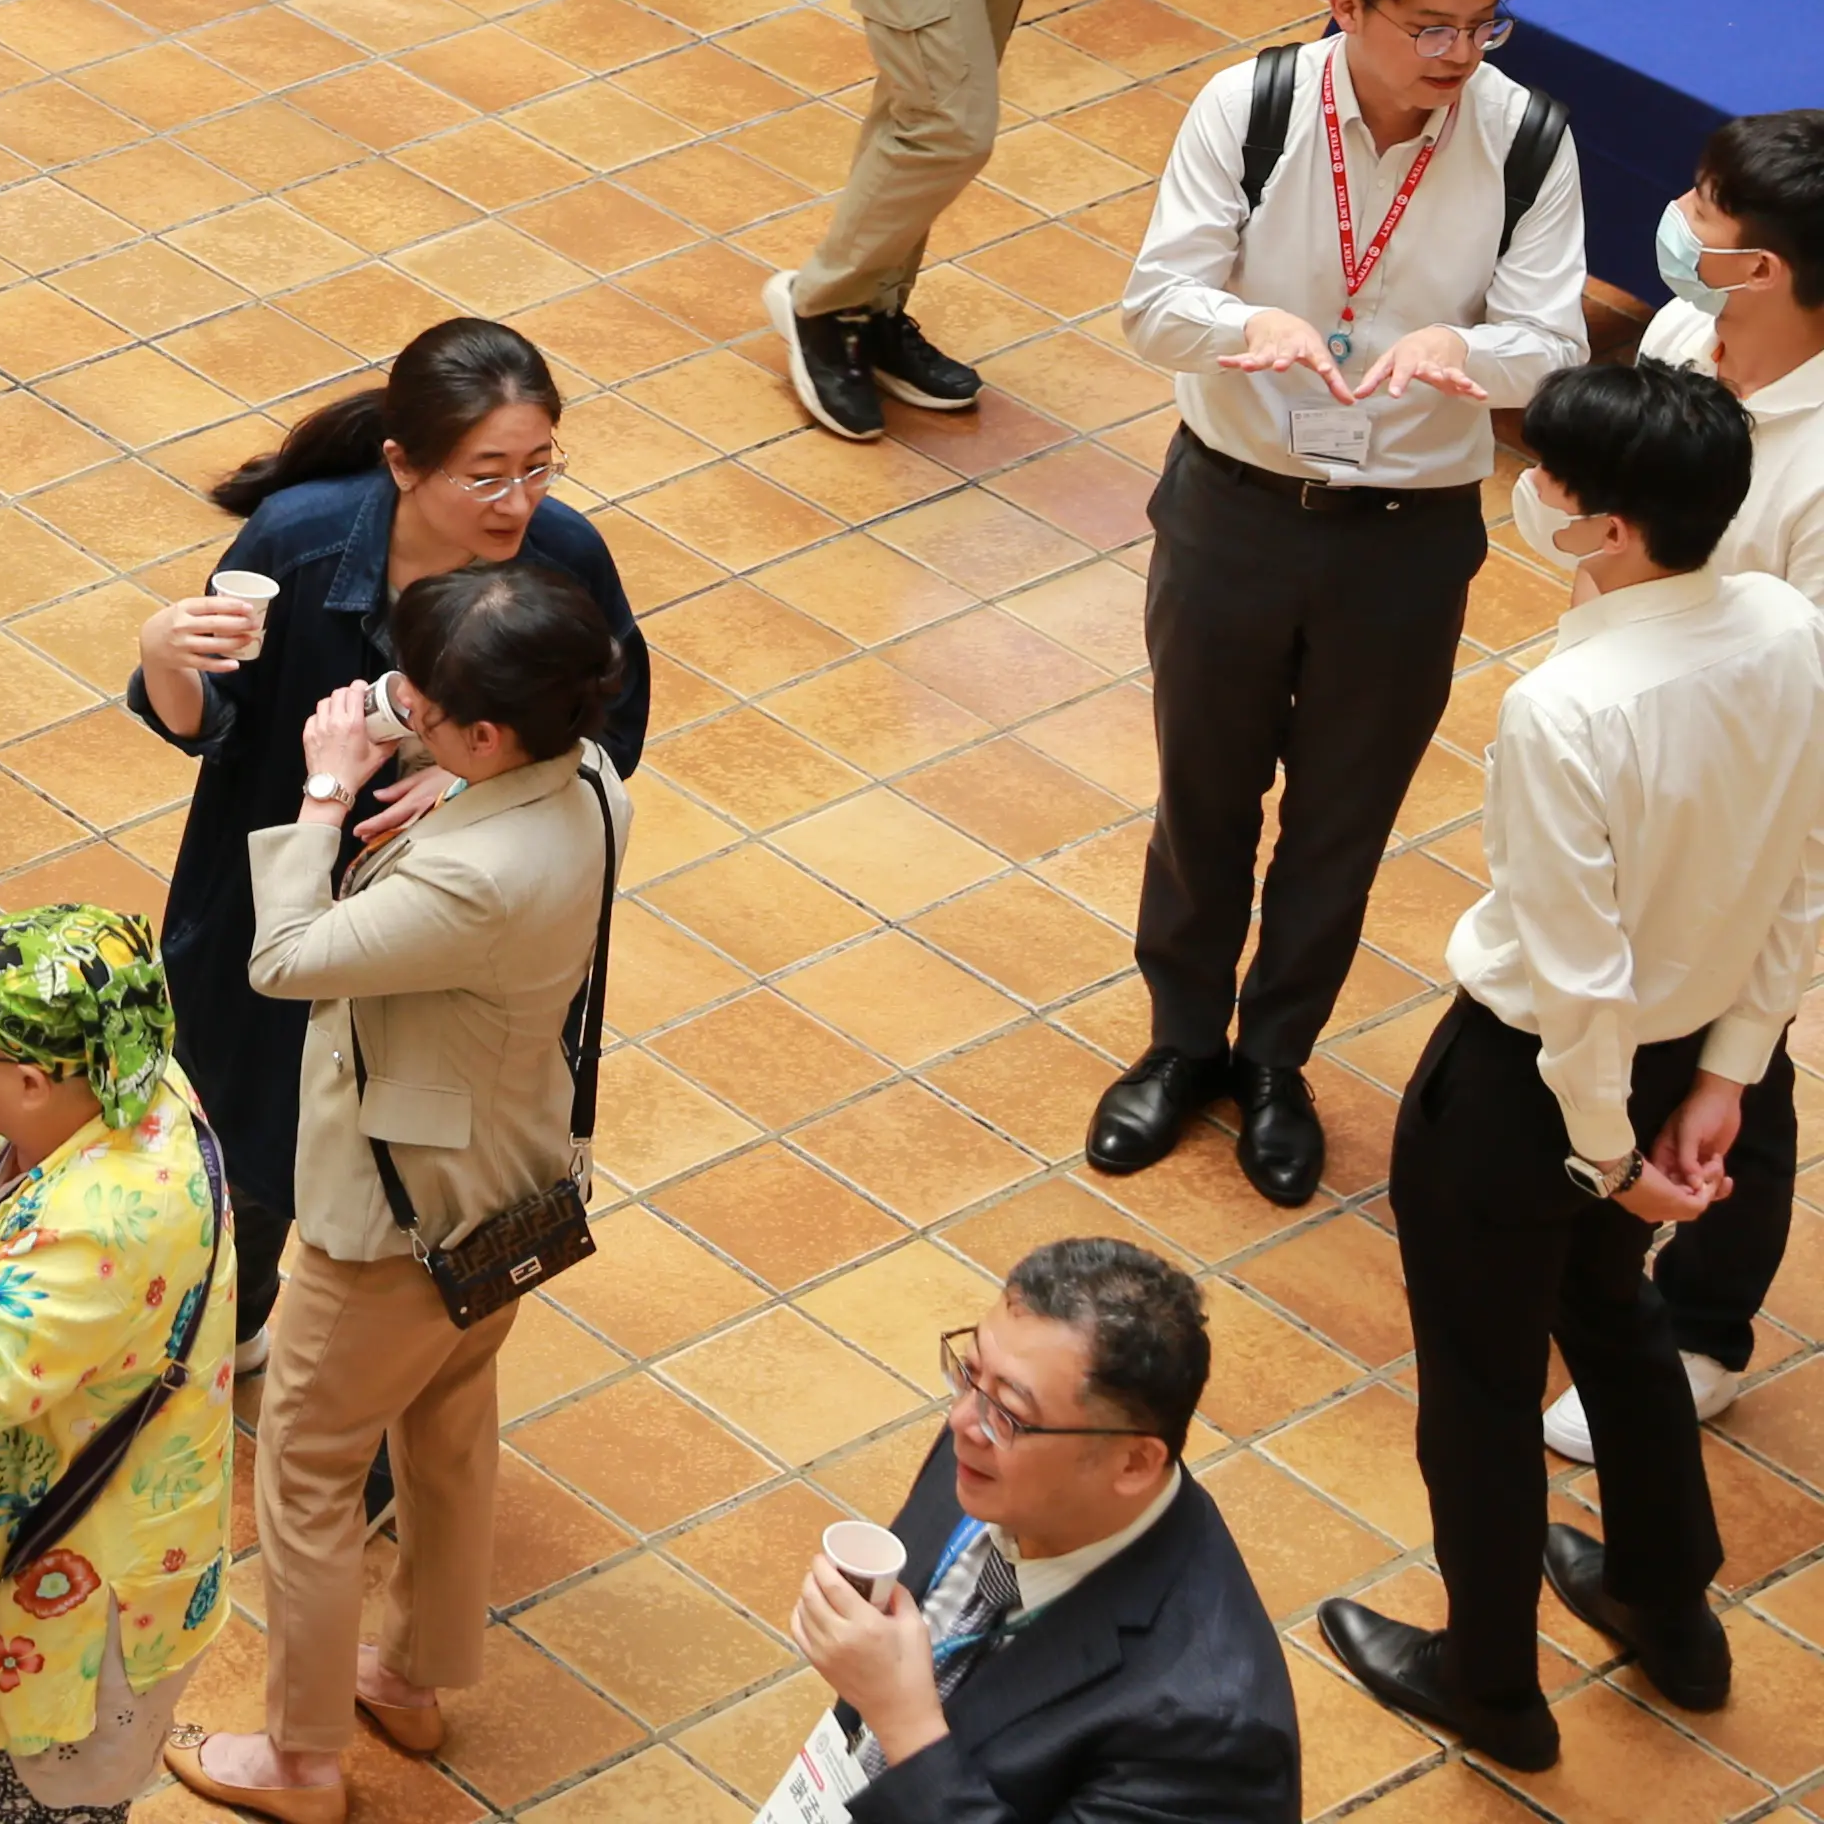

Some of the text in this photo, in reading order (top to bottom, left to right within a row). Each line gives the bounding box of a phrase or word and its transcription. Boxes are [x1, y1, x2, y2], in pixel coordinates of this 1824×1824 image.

[1328, 126, 1343, 161] DETEKT
[1334, 184, 1349, 219] DETEKT
[1380, 205, 1402, 238] DETEKT
